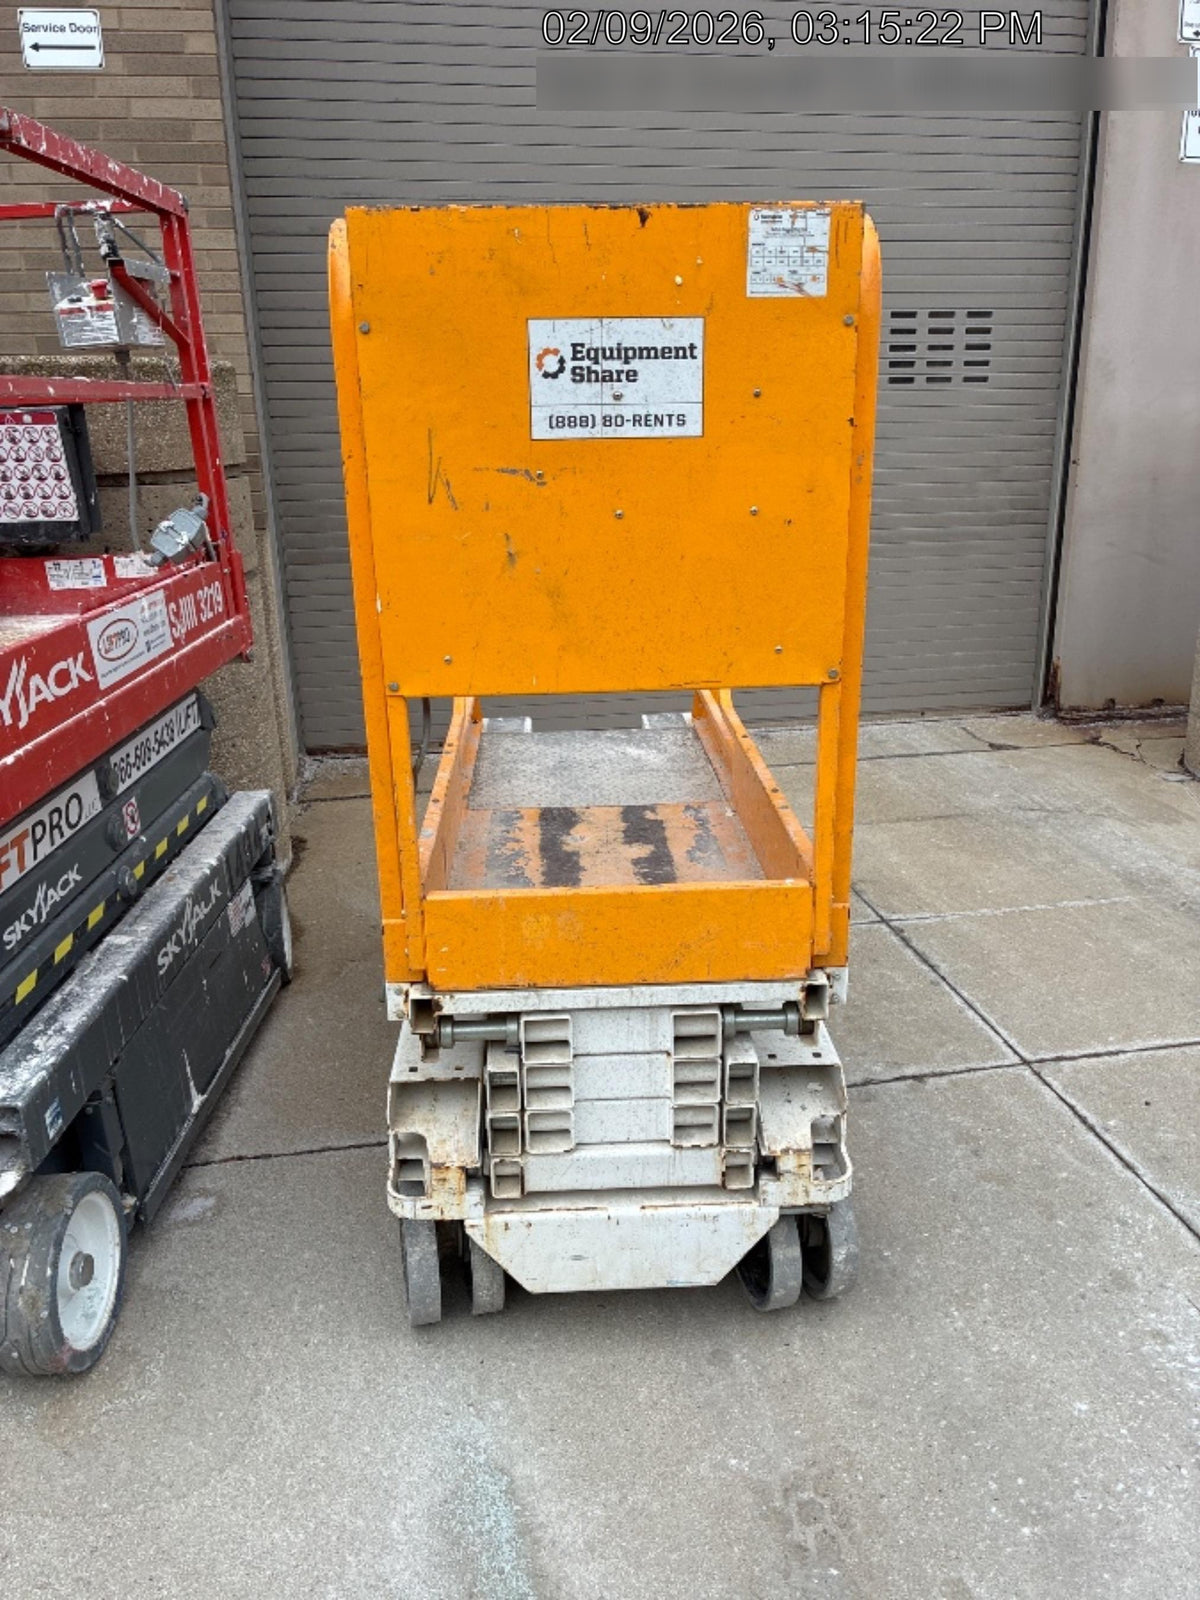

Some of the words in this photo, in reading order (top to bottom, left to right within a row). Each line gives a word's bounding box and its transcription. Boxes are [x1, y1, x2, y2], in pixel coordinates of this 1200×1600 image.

[22, 22, 66, 33] Service
[68, 22, 98, 33] Door
[570, 342, 697, 365] Equipment
[570, 365, 638, 383] Share
[549, 414, 597, 429] (888)
[602, 413, 687, 428] 80-RENTS
[196, 581, 223, 622] 3219
[3, 863, 83, 951] SKYJACK
